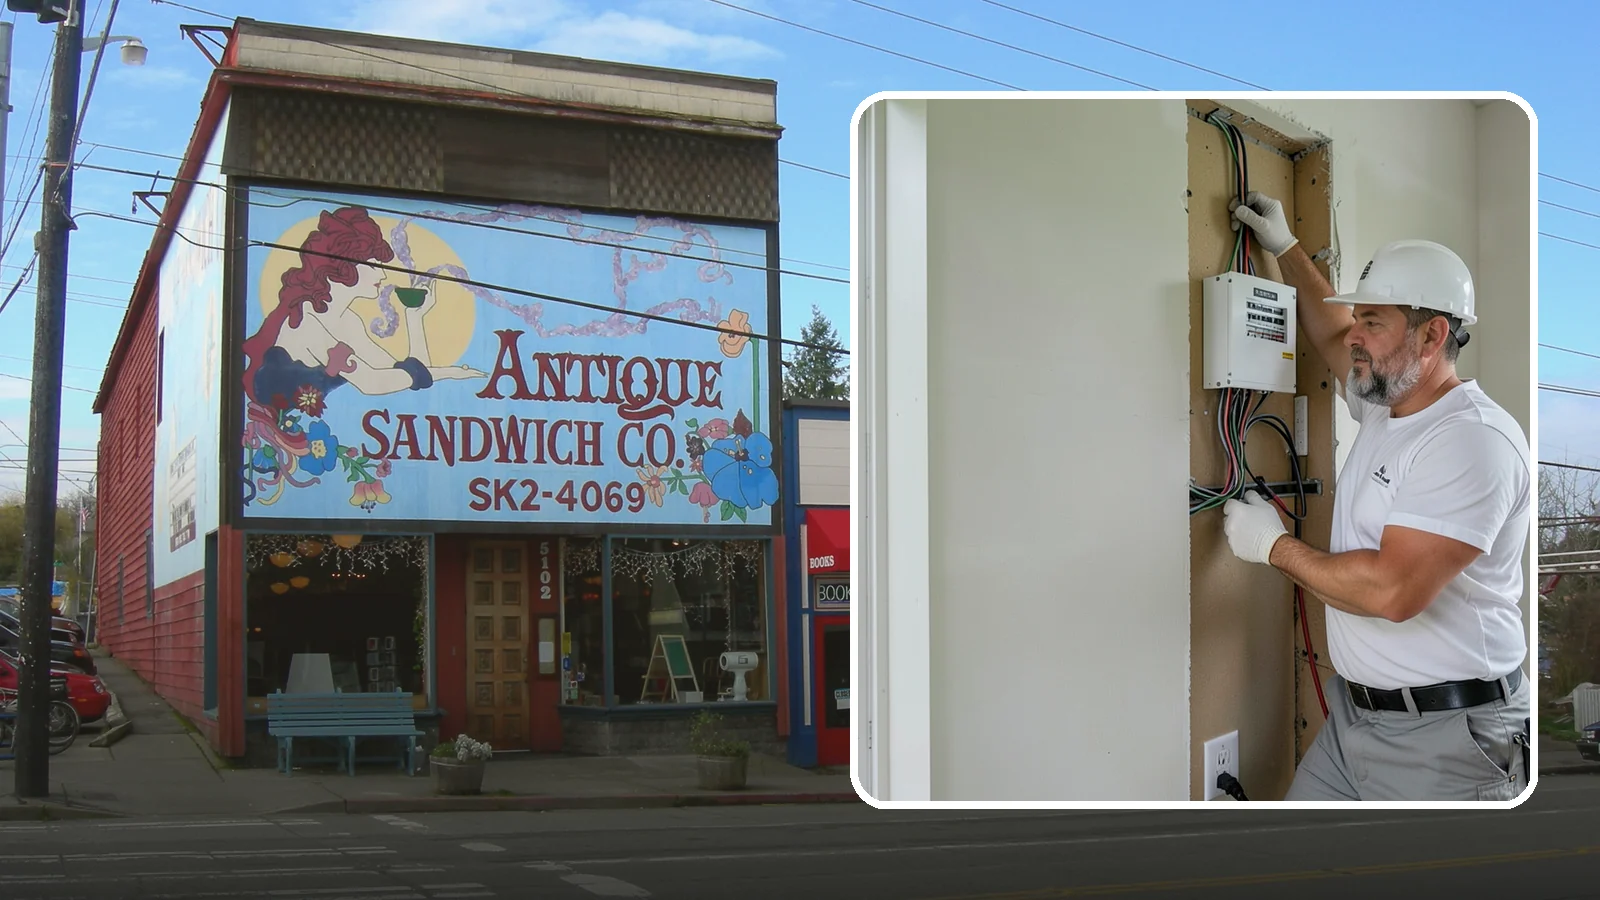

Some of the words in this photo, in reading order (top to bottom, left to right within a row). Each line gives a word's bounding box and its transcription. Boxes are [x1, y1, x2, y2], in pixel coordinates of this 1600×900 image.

[476, 328, 723, 420] ANTIQUE
[361, 408, 604, 467] SANDWICH
[617, 421, 685, 468] CO.
[468, 476, 646, 513] SK2-4069
[540, 541, 551, 600] 5102
[809, 555, 835, 569] BOOKS
